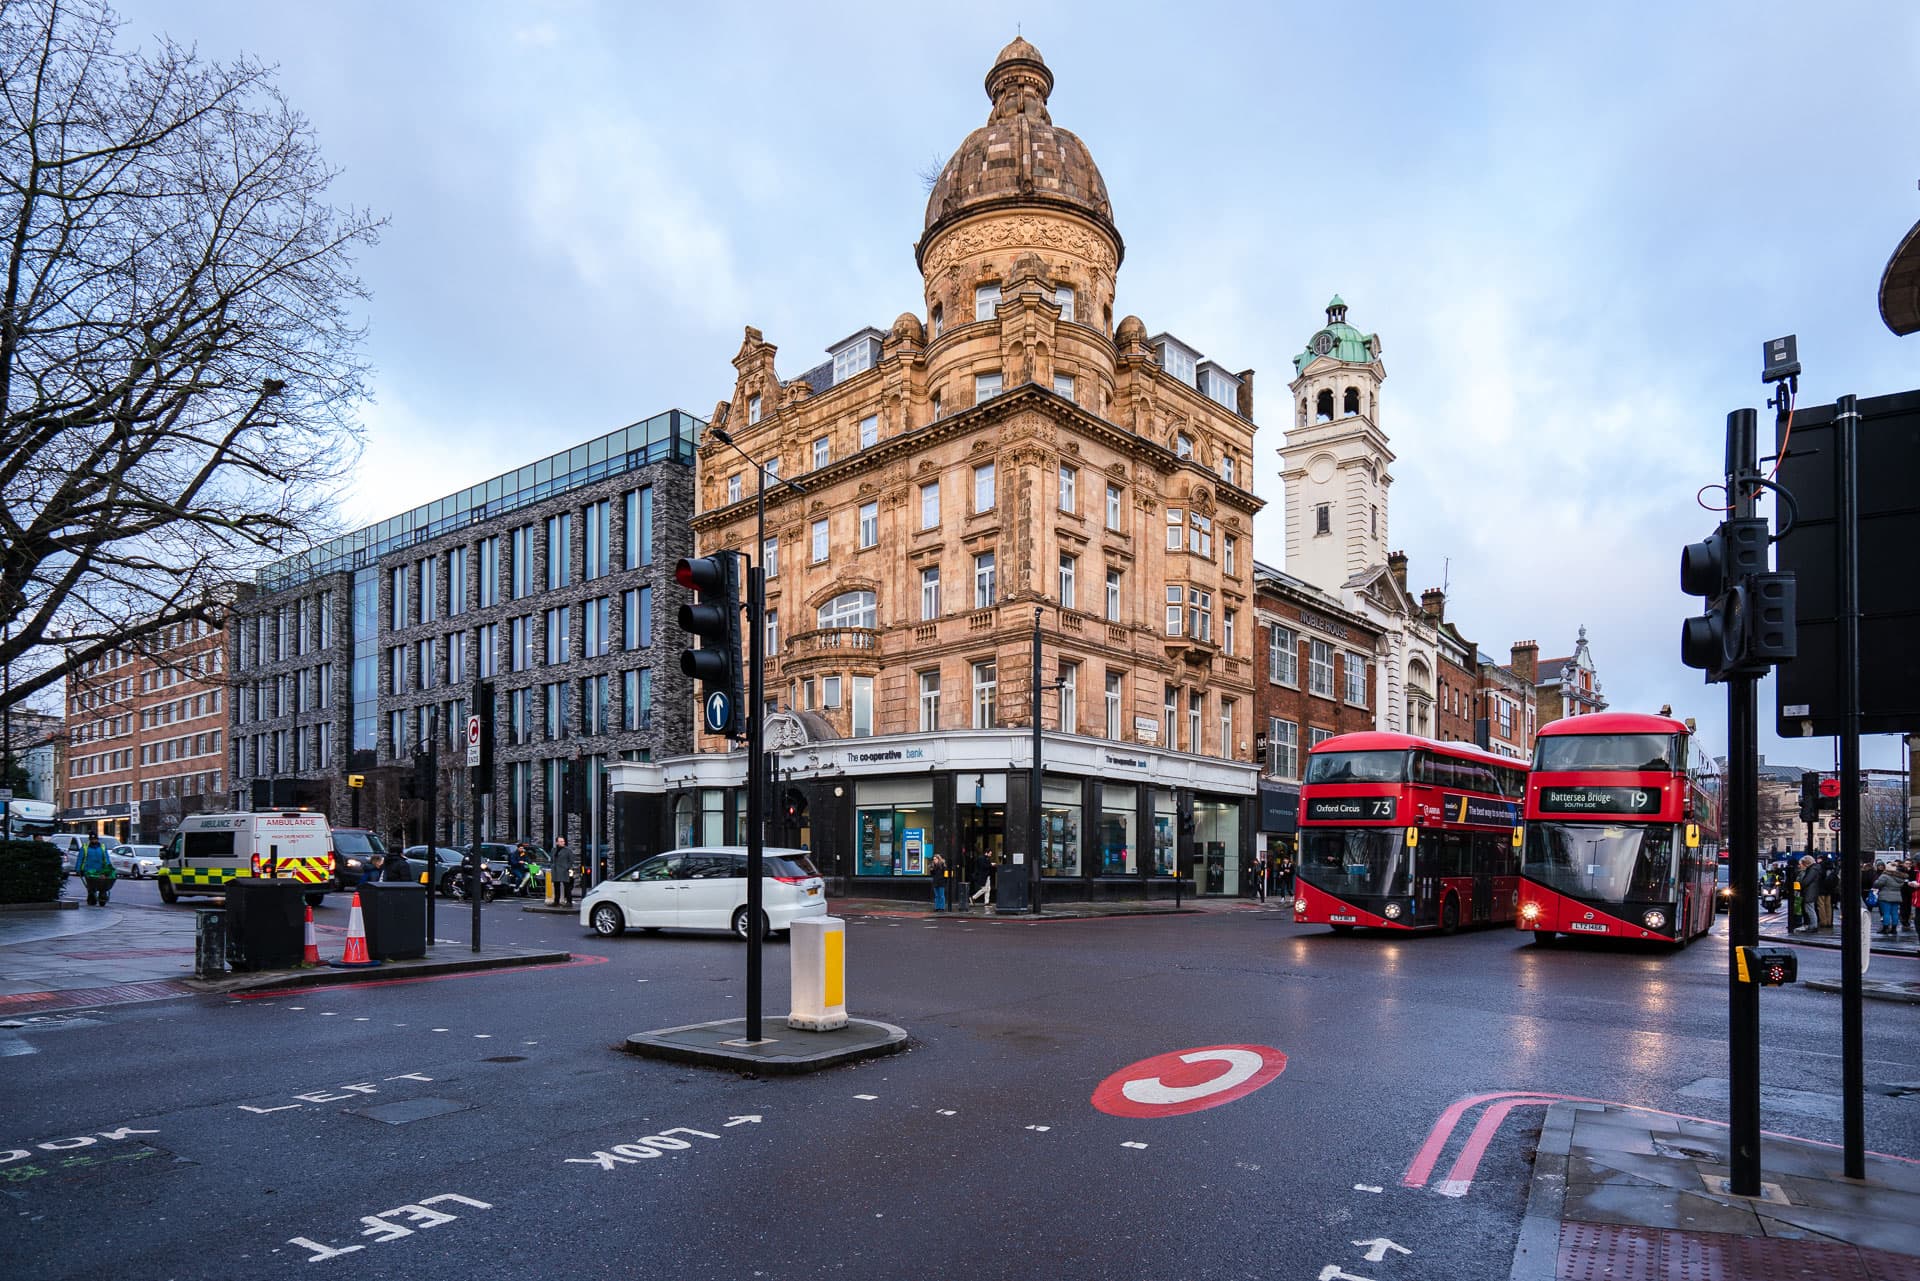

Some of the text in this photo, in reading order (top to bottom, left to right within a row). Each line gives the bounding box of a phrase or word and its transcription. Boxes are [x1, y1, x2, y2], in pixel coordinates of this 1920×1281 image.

[1299, 610, 1349, 639] NOBLE HOUSE
[847, 747, 924, 764] The co-operative bank
[1551, 791, 1611, 804] Battersea Bridge
[1630, 791, 1648, 808] 19
[1316, 804, 1360, 813] Oxford Circus
[1372, 801, 1391, 815] 73
[1468, 805, 1477, 815] The
[199, 819, 231, 828] AMBULANCE
[266, 818, 316, 826] AMBULANCE
[237, 1072, 433, 1114] LEFT
[564, 1127, 720, 1170] LOOK
[287, 1193, 494, 1263] LEFT
